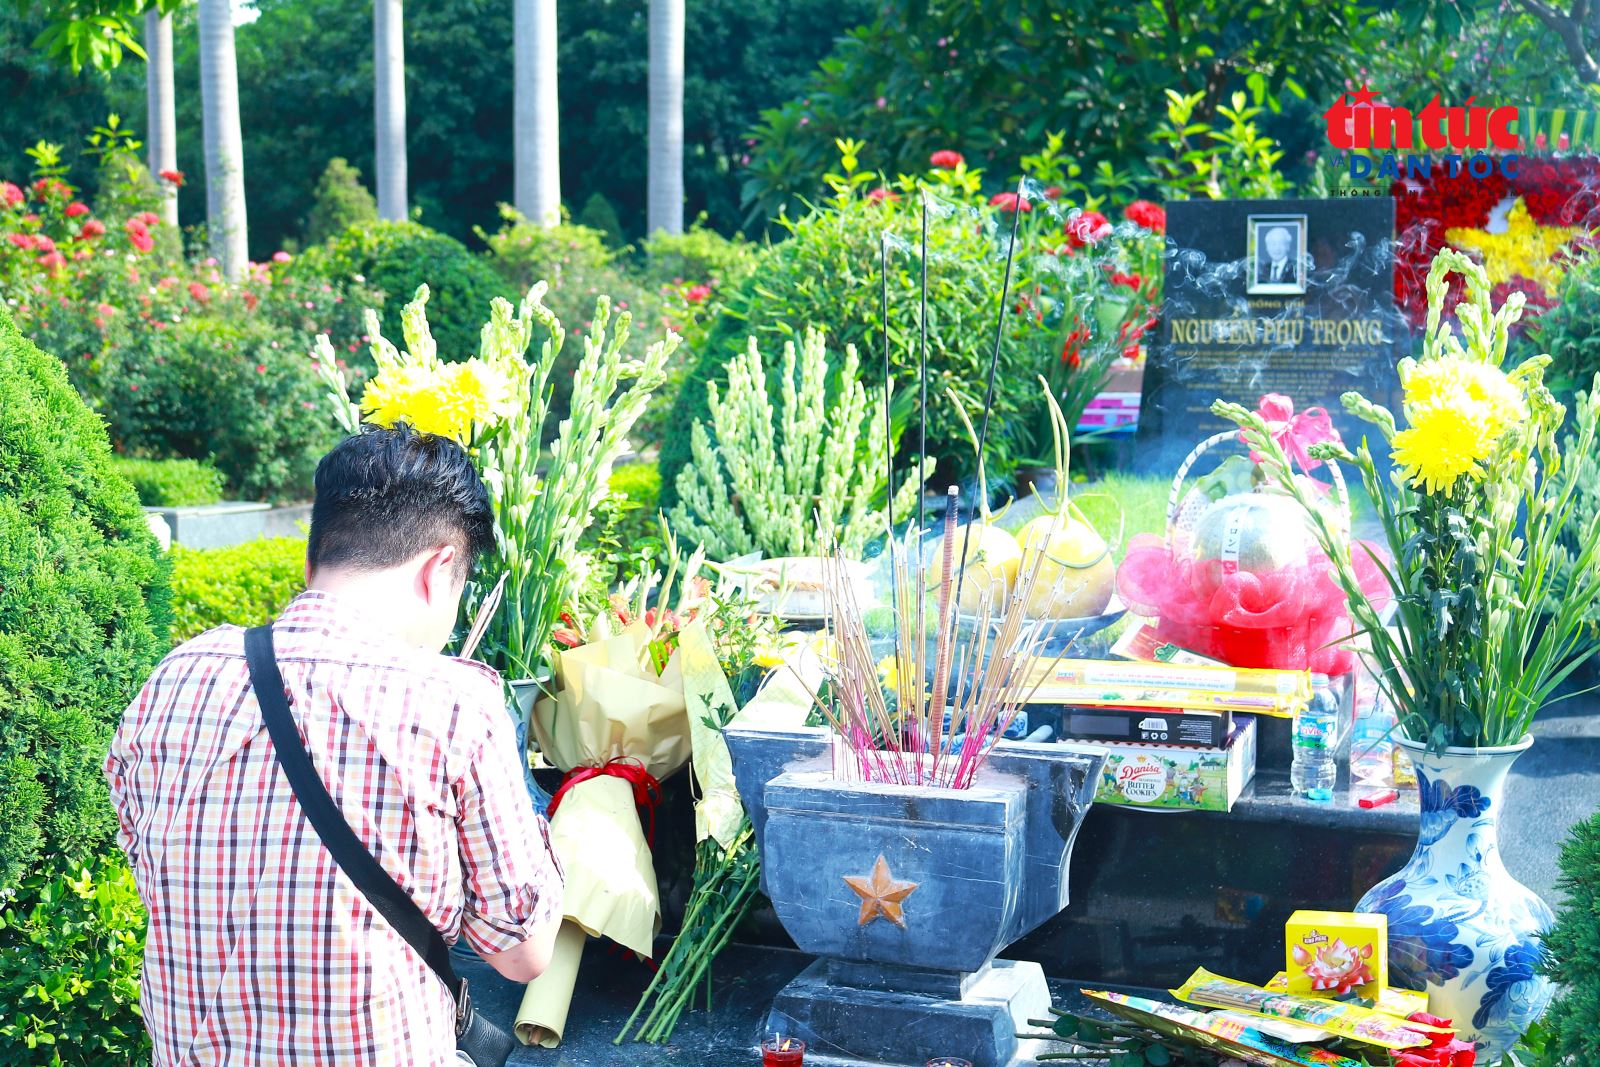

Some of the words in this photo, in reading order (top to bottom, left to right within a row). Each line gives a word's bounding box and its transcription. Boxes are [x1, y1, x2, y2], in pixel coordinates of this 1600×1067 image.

[1310, 318, 1384, 351] TRỌNG
[1120, 763, 1161, 780] Danisa
[1127, 781, 1156, 790] BUTTER
[1126, 788, 1158, 797] COOKIES
